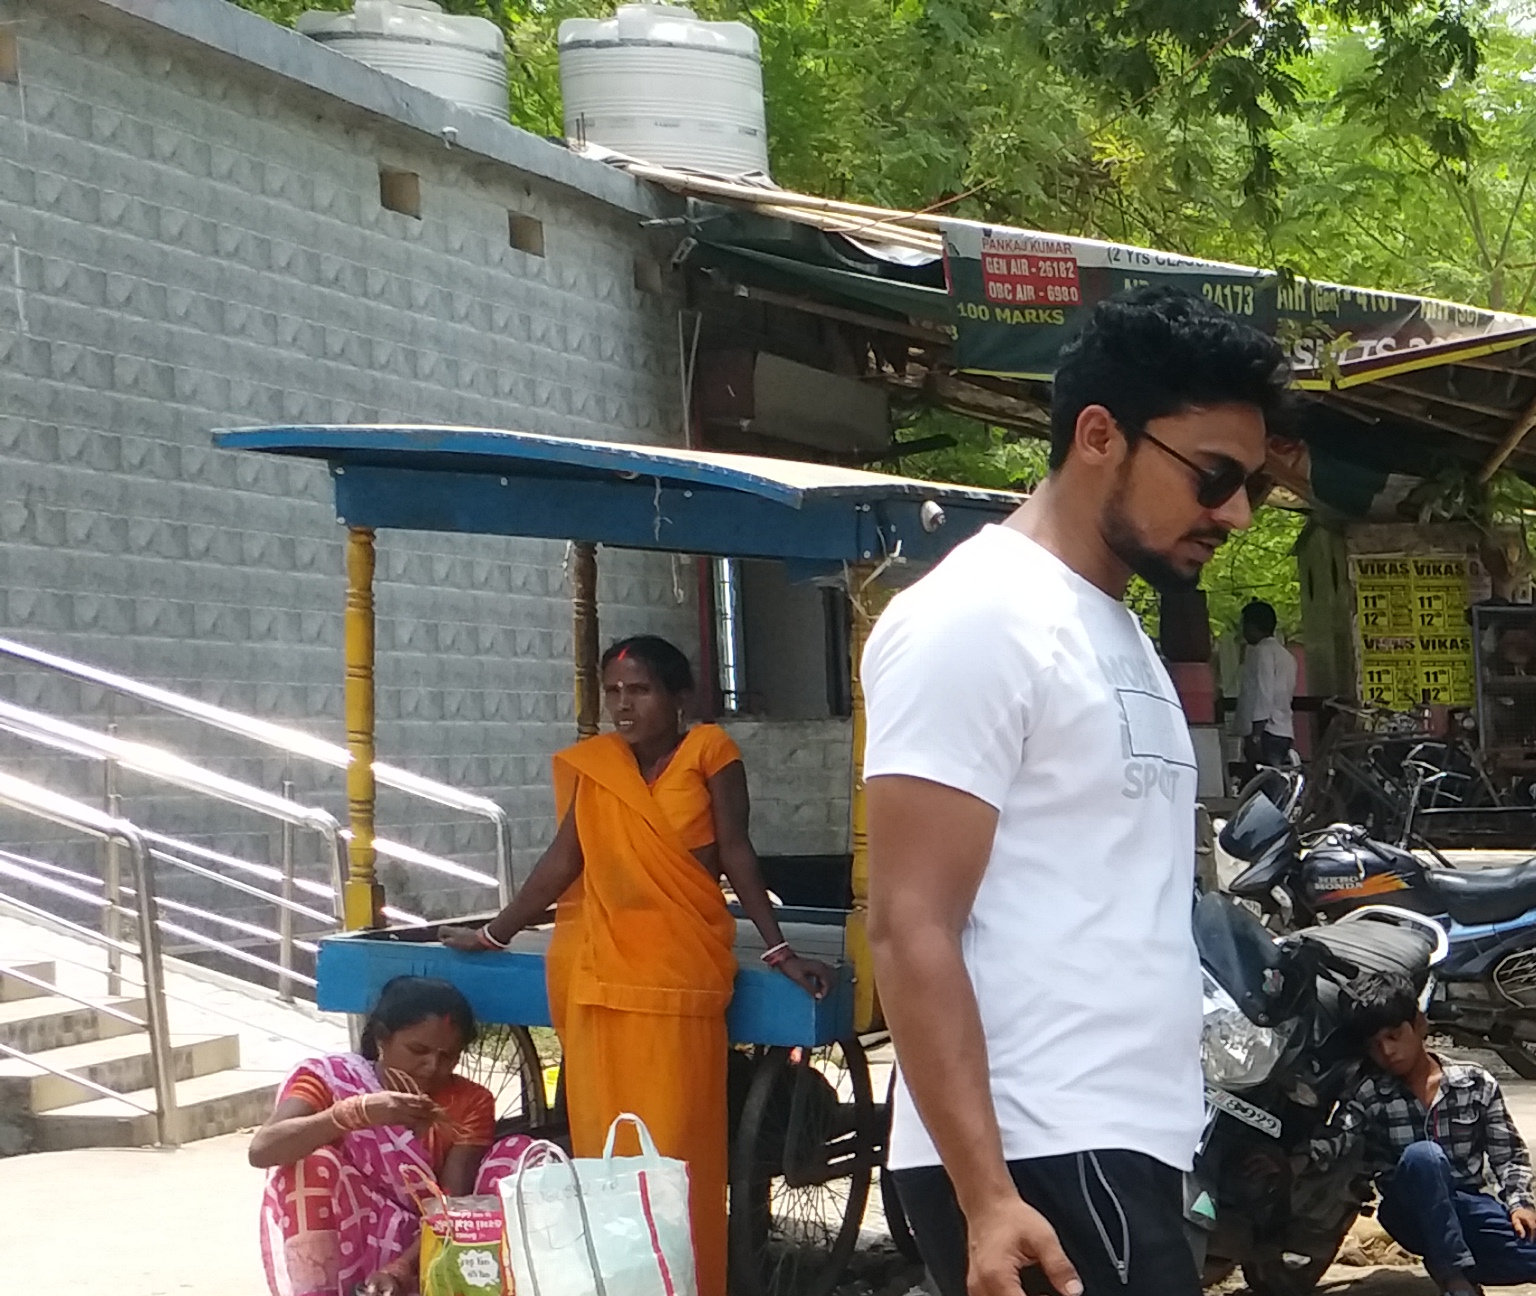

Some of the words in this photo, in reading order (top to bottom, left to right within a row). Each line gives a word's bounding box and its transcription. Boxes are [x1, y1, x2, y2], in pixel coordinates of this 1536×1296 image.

[981, 237, 1028, 254] PANKAJ
[1029, 241, 1073, 256] KUMAR
[985, 258, 1008, 276] GEN
[1010, 259, 1030, 277] AIR
[1038, 261, 1076, 279] 26182
[988, 281, 1013, 300] OBC
[1015, 283, 1036, 302] AIR
[1047, 284, 1079, 303] 6980
[957, 302, 990, 322] 100
[995, 307, 1065, 326] MARKS
[1358, 559, 1410, 577] VIKAS
[1413, 559, 1466, 577] VIKAS
[1419, 635, 1471, 651] VIKAS
[1314, 882, 1364, 891] HONDA
[1317, 875, 1360, 884] HERO
